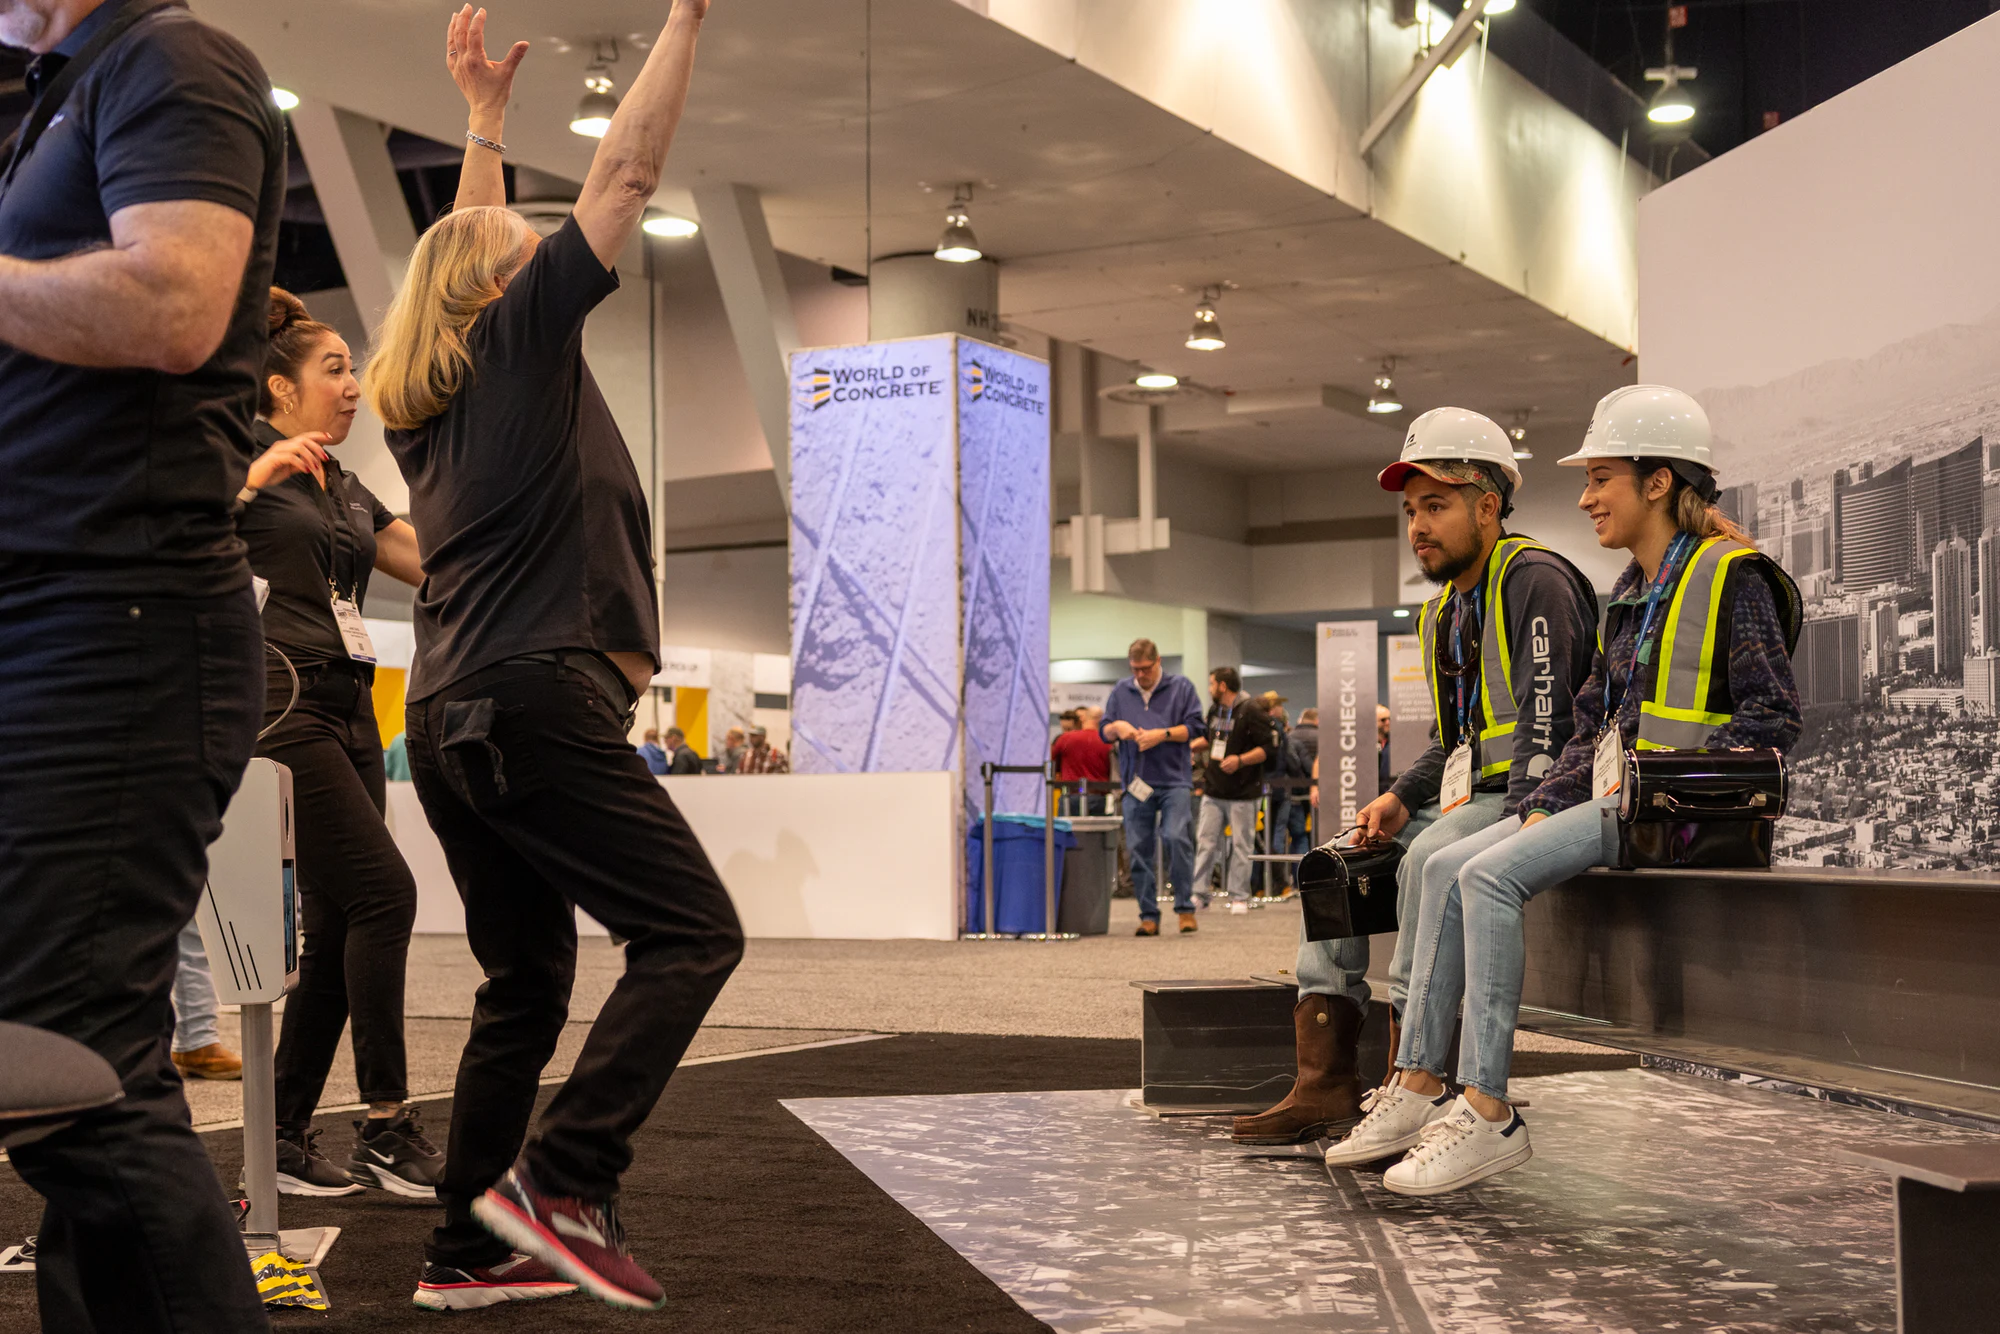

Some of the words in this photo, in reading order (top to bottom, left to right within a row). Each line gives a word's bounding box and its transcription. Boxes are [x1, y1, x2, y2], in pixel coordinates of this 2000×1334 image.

[833, 366, 904, 384] WORLD
[911, 365, 931, 377] OF
[984, 368, 1024, 391] WORLD
[1027, 384, 1039, 395] OF
[833, 381, 941, 402] CONCRETE
[984, 385, 1044, 415] CONCRETE
[1340, 651, 1356, 672] IN
[1531, 616, 1555, 750] carhartt
[1340, 677, 1357, 751] CHECK
[1340, 756, 1357, 829] IBITOR
